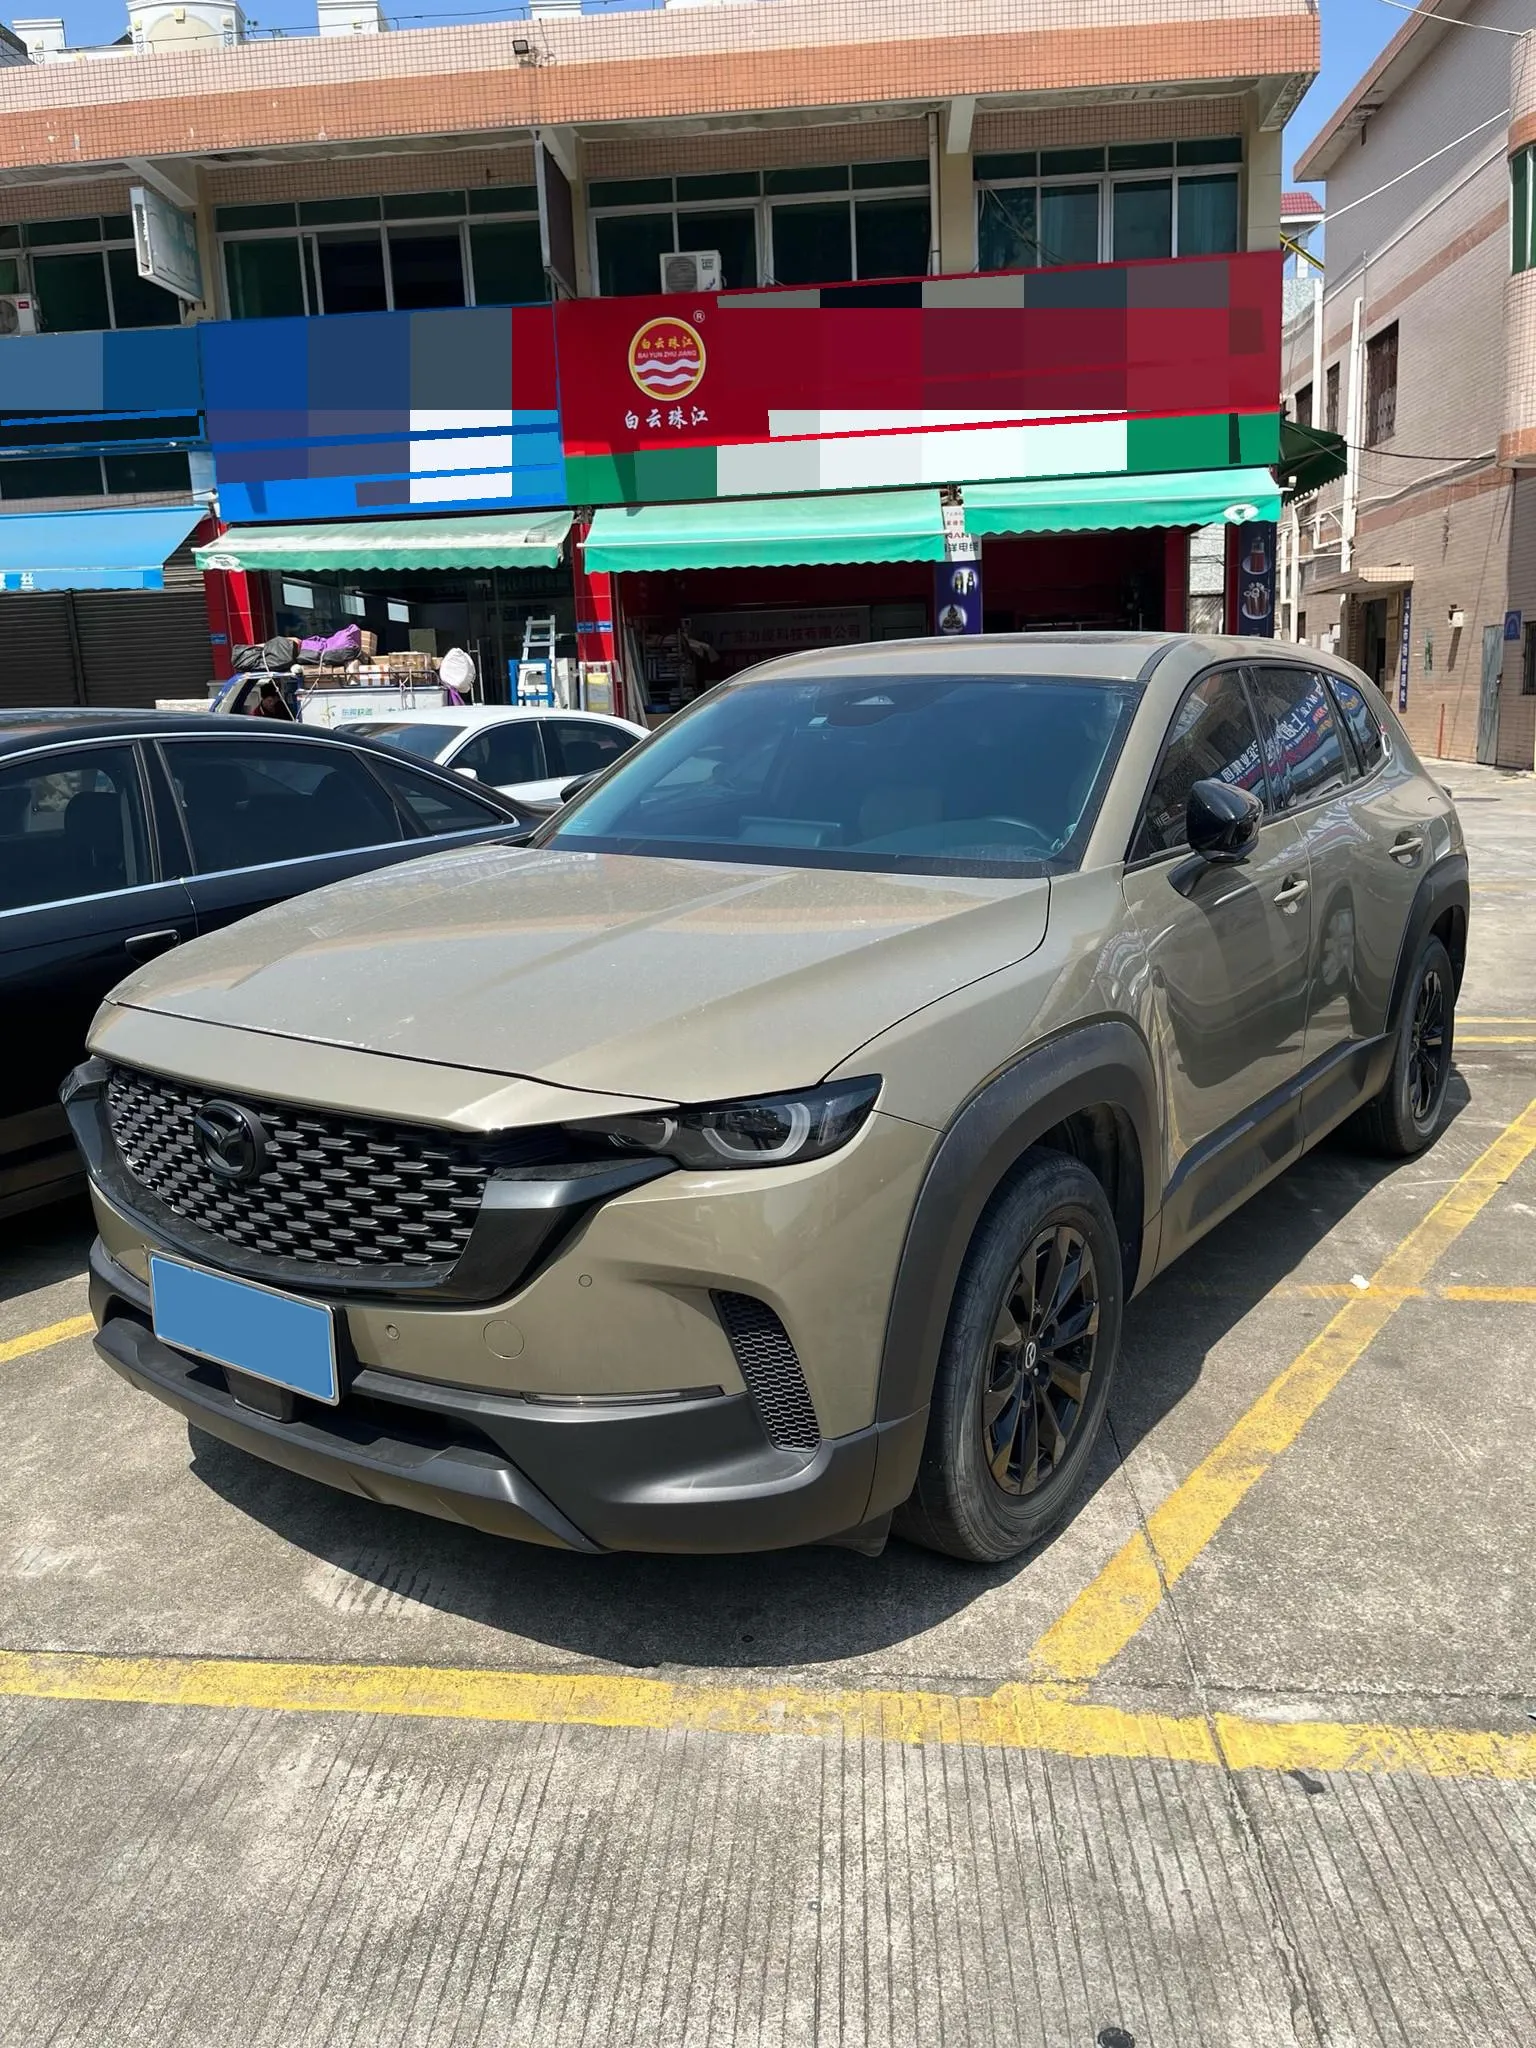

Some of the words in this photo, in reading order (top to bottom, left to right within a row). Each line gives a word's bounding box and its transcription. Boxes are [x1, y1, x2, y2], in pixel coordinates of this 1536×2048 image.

[641, 336, 693, 350] 白云珠江
[650, 351, 663, 359] YUN
[664, 350, 677, 358] ZHU
[678, 349, 697, 357] JIANG
[624, 406, 709, 430] 白云珠江
